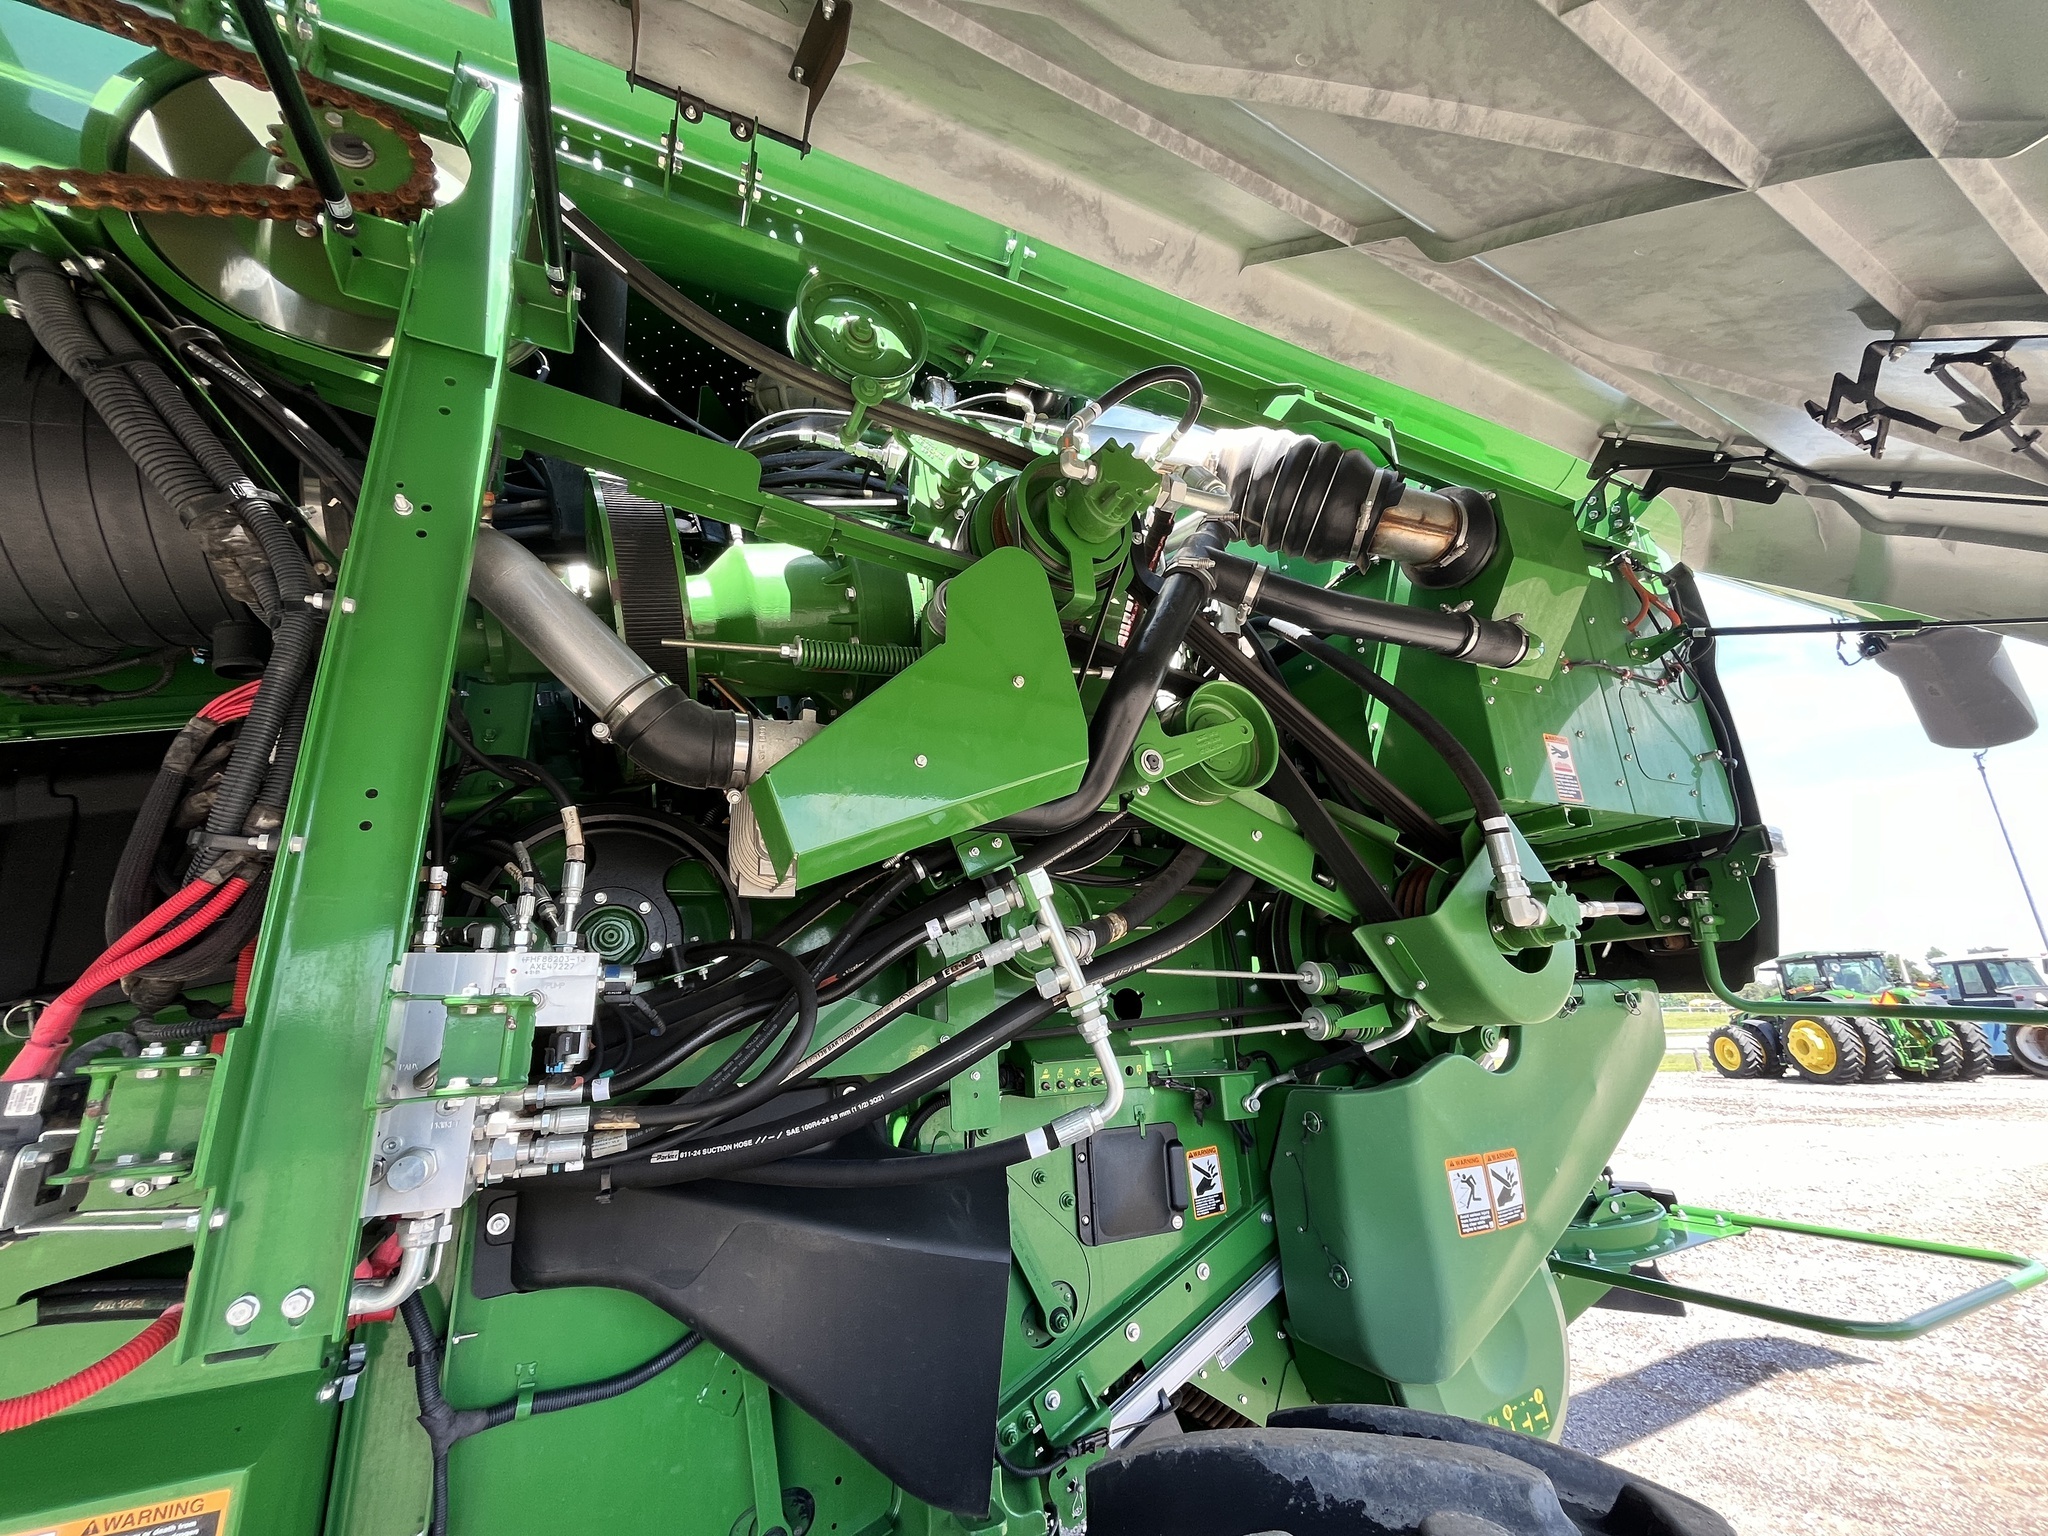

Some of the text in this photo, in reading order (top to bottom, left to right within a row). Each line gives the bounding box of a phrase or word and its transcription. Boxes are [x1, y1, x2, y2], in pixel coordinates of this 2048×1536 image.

[653, 1151, 679, 1162] Parker
[702, 1144, 733, 1155] SUCTION
[733, 1139, 753, 1149] HOSE
[786, 1126, 801, 1137] SAE
[839, 1109, 852, 1118] mm
[1193, 1147, 1217, 1157] WARNING
[1492, 1150, 1515, 1161] WARNING
[1455, 1157, 1480, 1167] WARNING
[103, 1498, 205, 1532] WARNING
